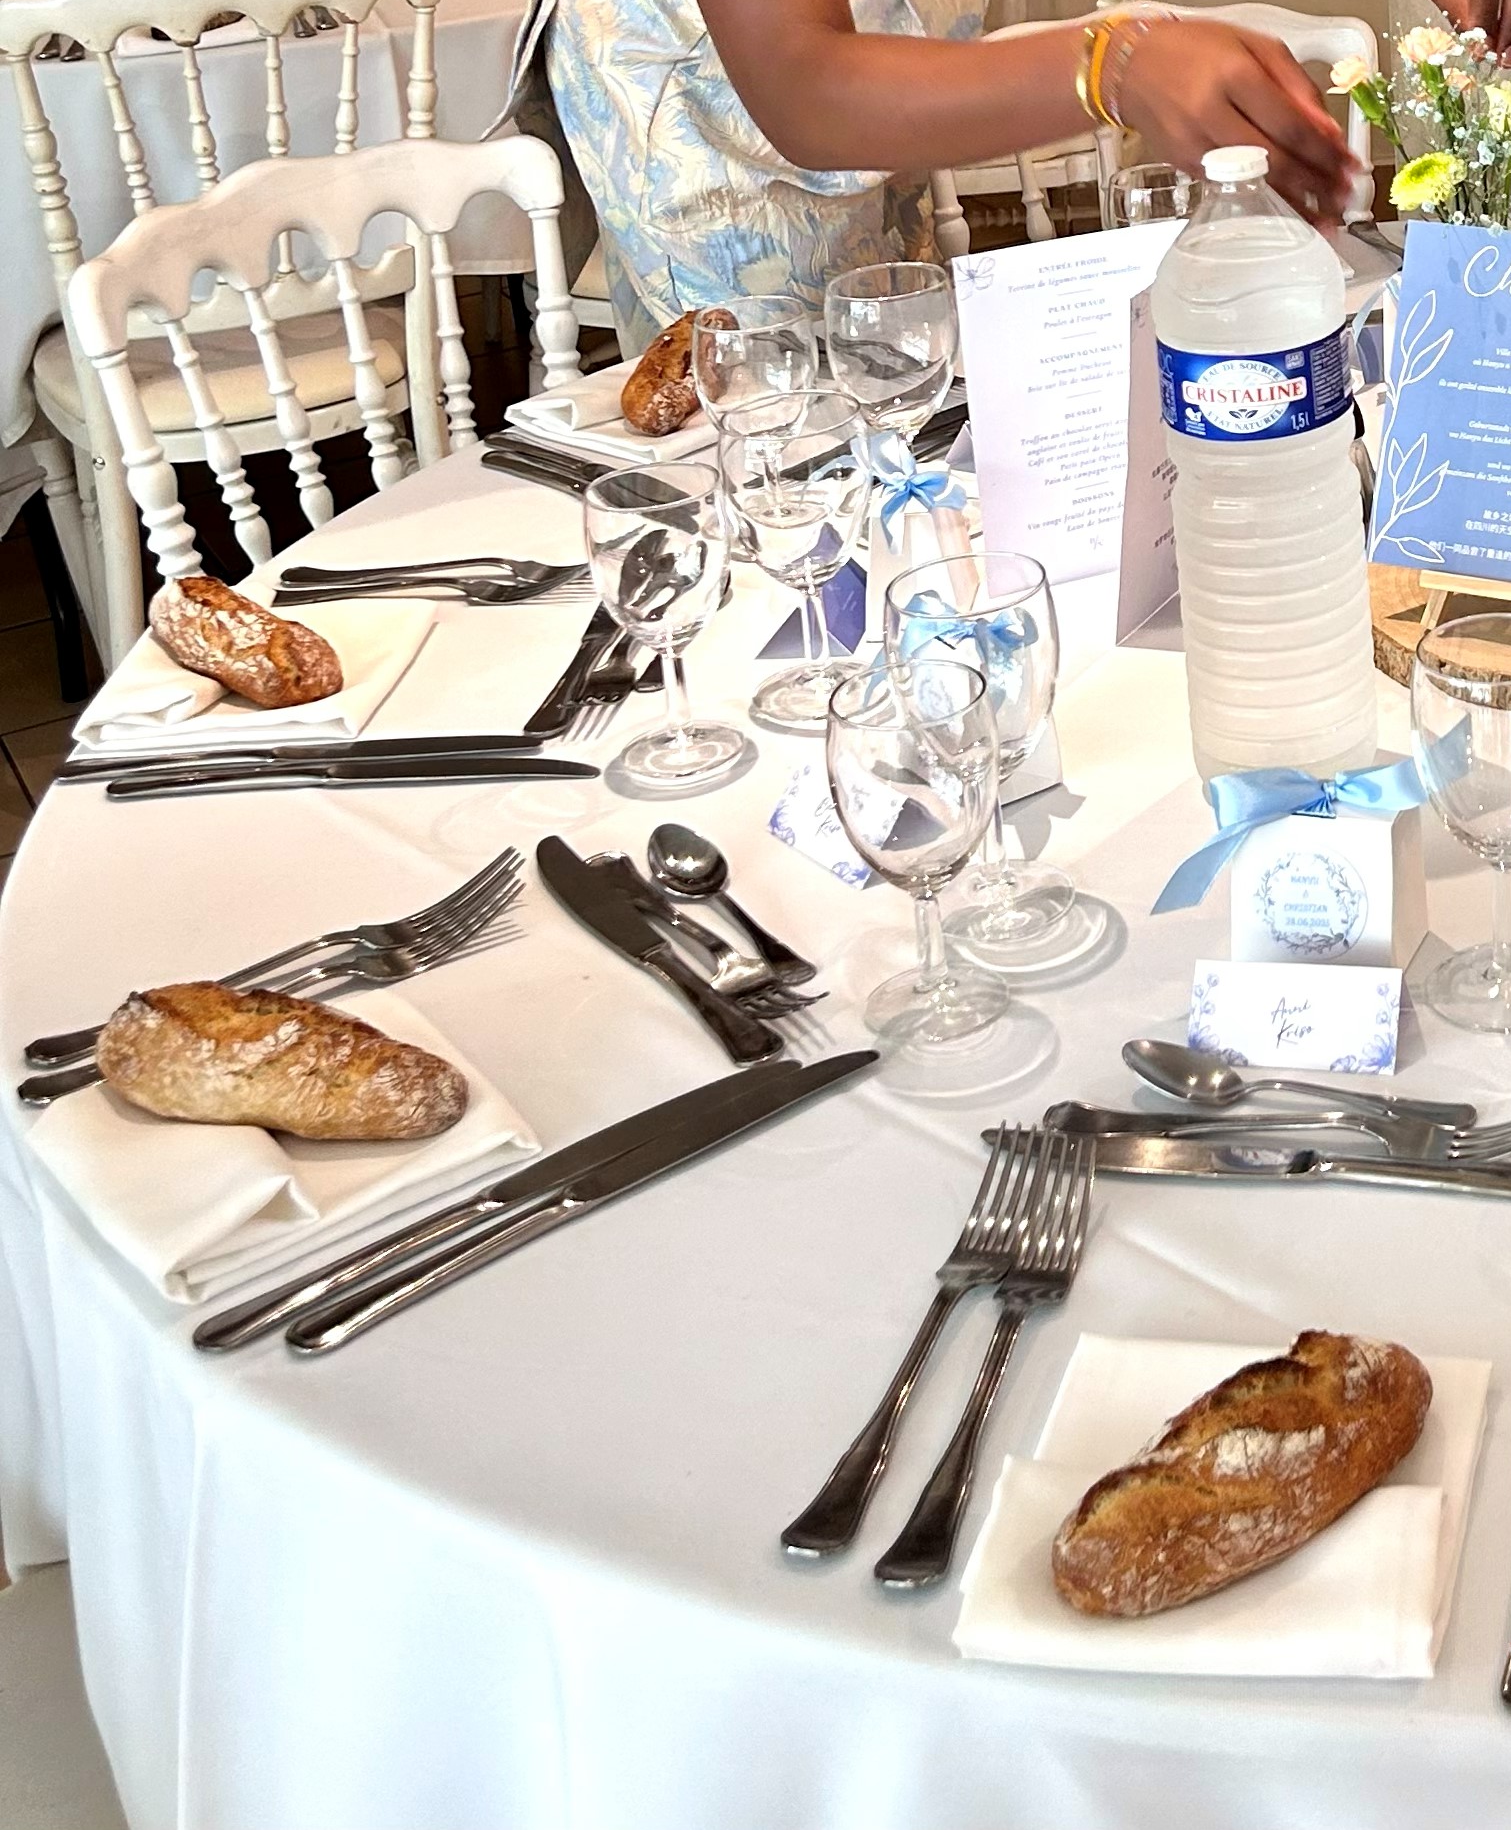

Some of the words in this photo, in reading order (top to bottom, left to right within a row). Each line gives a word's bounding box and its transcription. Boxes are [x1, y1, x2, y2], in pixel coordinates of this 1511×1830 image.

[1049, 304, 1071, 313] PLAT
[1240, 363, 1280, 381] SOURCE
[1185, 381, 1303, 403] CRISTALINE
